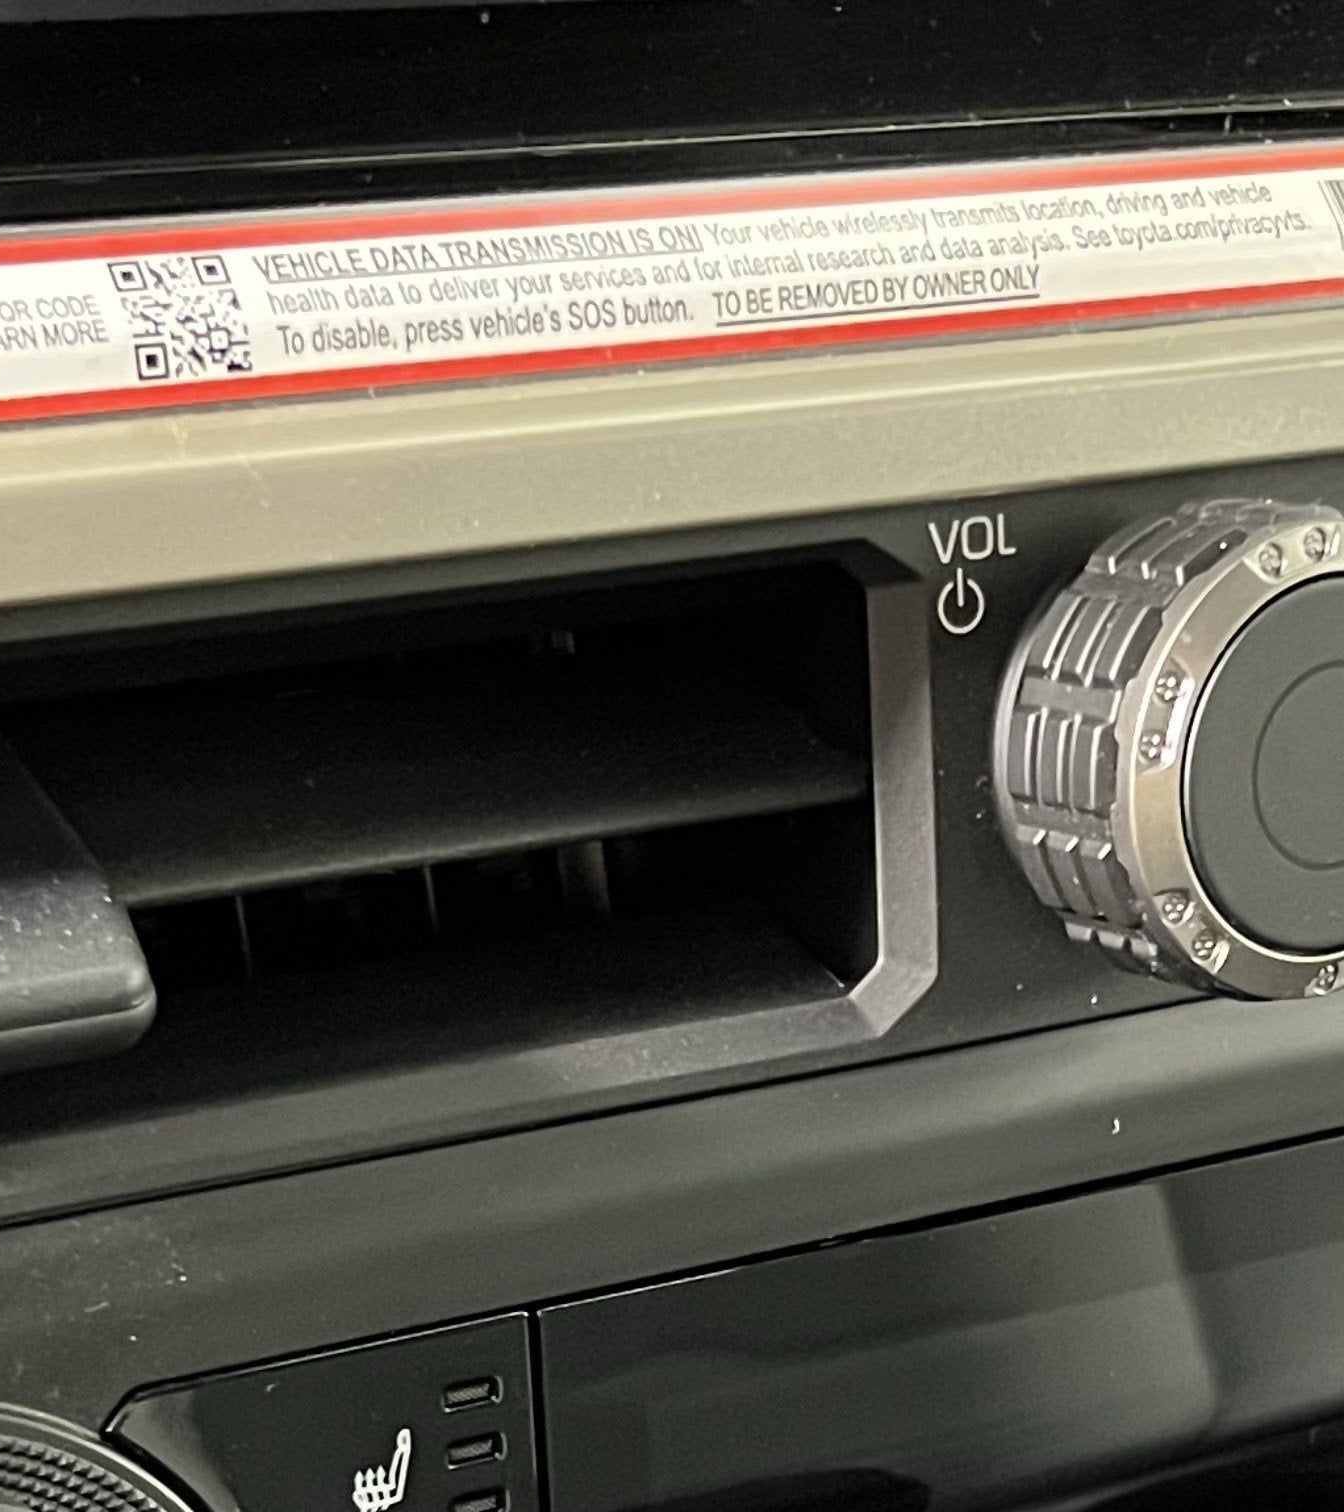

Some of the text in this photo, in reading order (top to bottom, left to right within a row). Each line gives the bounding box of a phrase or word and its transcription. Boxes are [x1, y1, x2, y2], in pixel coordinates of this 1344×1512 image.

[252, 249, 367, 281] VEHICLE
[369, 244, 440, 273] DATA
[438, 229, 628, 269] TRANSMISSION
[628, 226, 655, 253] IS
[704, 222, 752, 246] Your
[757, 215, 830, 242] vehicle
[831, 209, 930, 237] wirelessly
[930, 201, 1020, 229] transmits
[1021, 195, 1105, 221] location,
[1106, 190, 1169, 217] driving
[1170, 186, 1206, 210] and
[1208, 181, 1273, 207] vehicle
[266, 285, 340, 316] health
[344, 283, 395, 310] data
[398, 280, 423, 305] to
[429, 276, 501, 303] deliver
[505, 271, 554, 303] your
[559, 264, 647, 292] services
[651, 258, 691, 284] and
[693, 256, 723, 281] for
[725, 247, 805, 278] internal
[806, 241, 896, 271] research
[899, 238, 936, 264] and
[940, 235, 984, 260] data
[1072, 224, 1112, 249] See
[35, 294, 101, 319] CODE
[41, 318, 110, 347] MORE
[276, 263, 1041, 357] To disable, press vehicle's SOS button. TO BE REMOVED BY OWNER ONLY
[927, 512, 1017, 564] VOL
